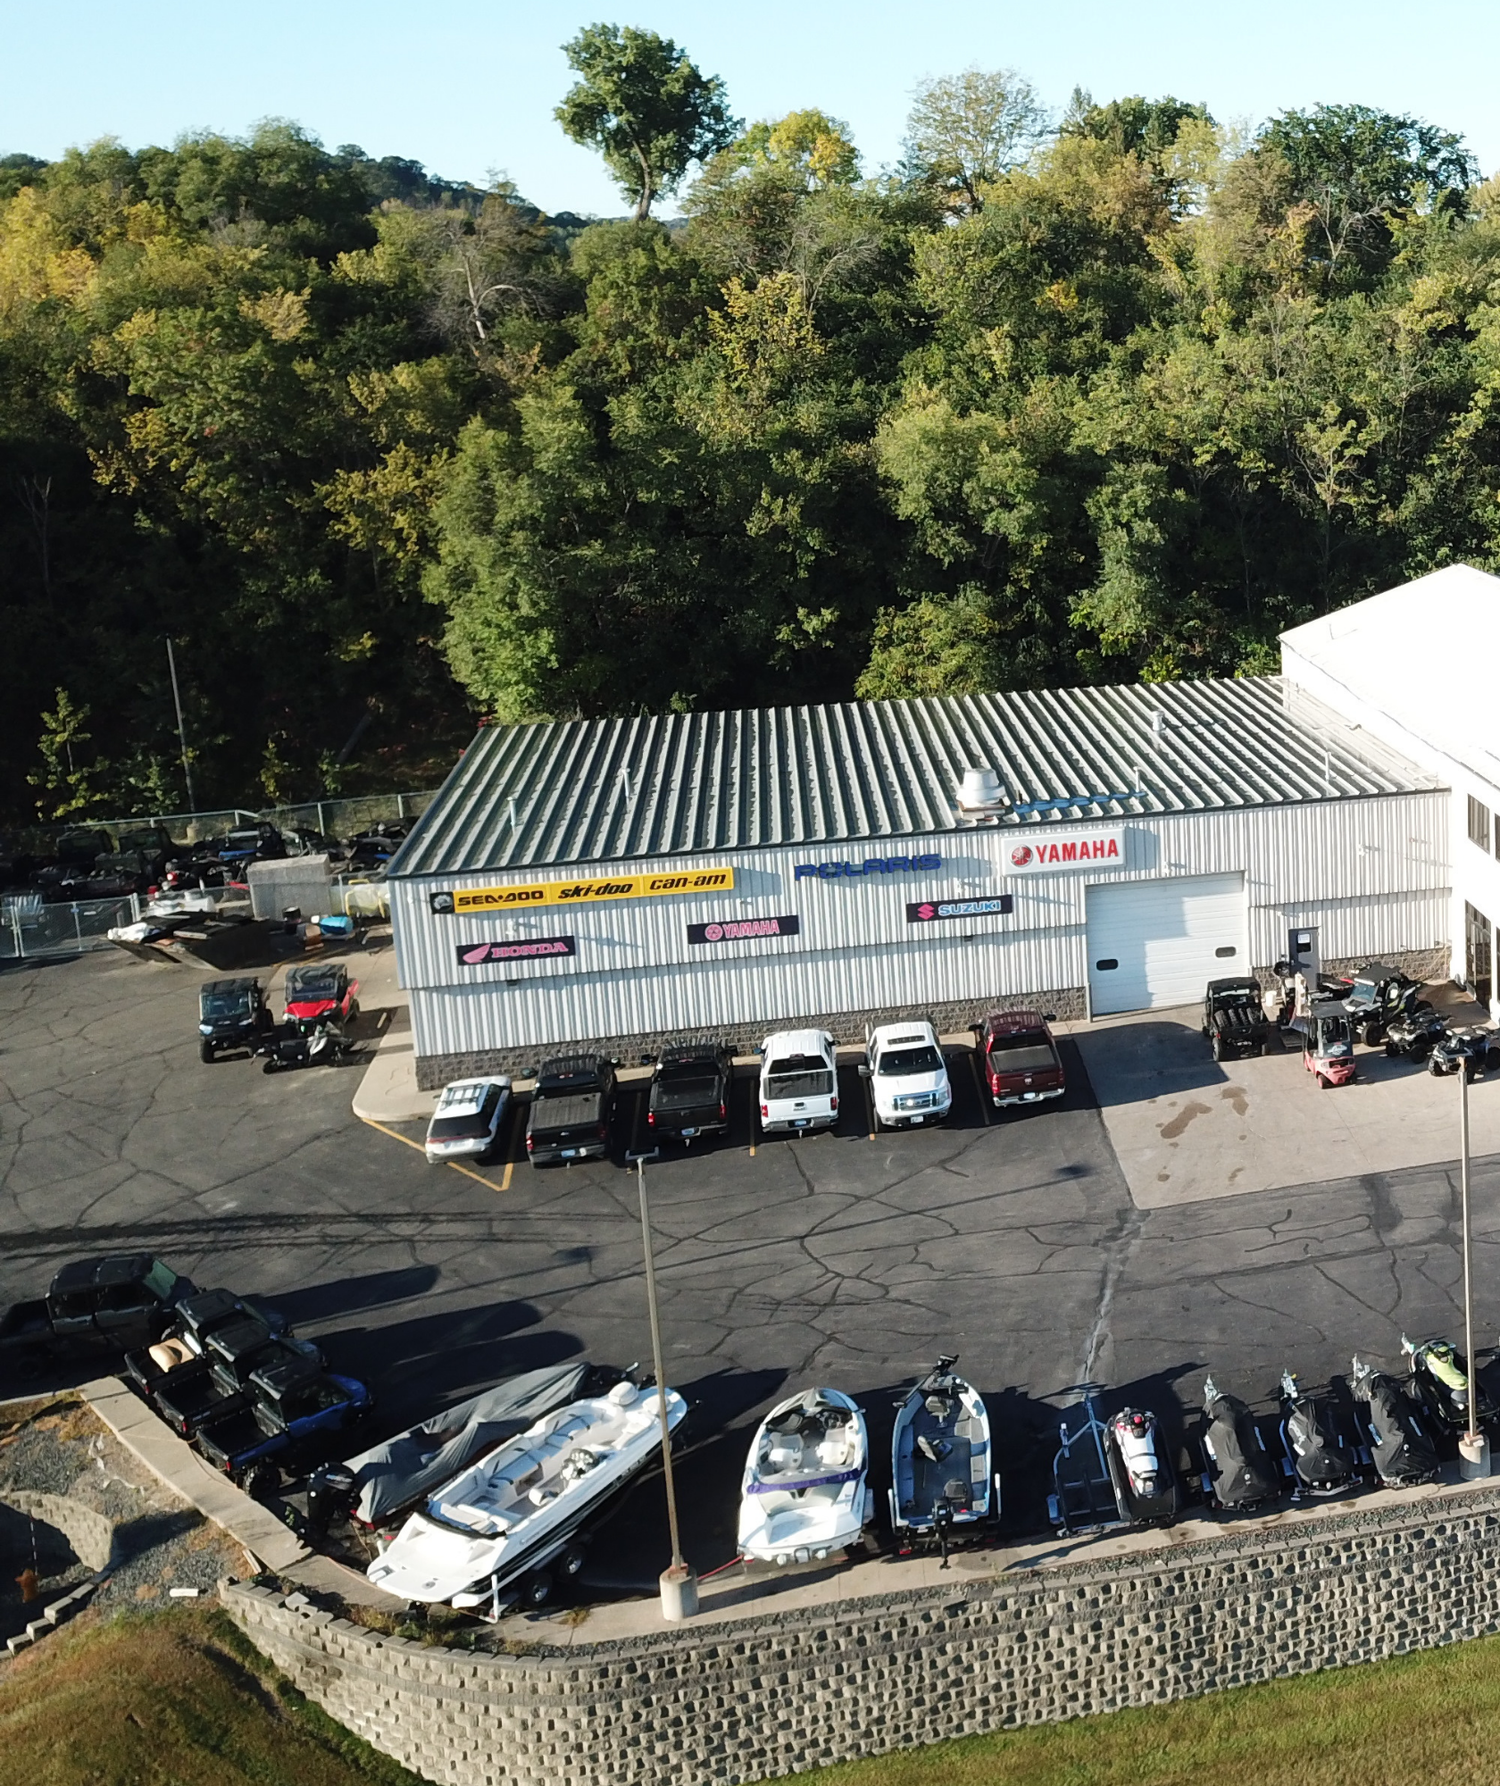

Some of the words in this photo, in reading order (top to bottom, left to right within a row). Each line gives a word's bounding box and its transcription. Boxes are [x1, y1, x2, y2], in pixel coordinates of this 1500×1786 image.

[1034, 838, 1119, 865] YAMAHA
[794, 852, 943, 882] POLARIS
[937, 899, 1001, 917] SUZUKI
[722, 919, 780, 939] YAMAHA
[491, 941, 569, 958] HONDA
